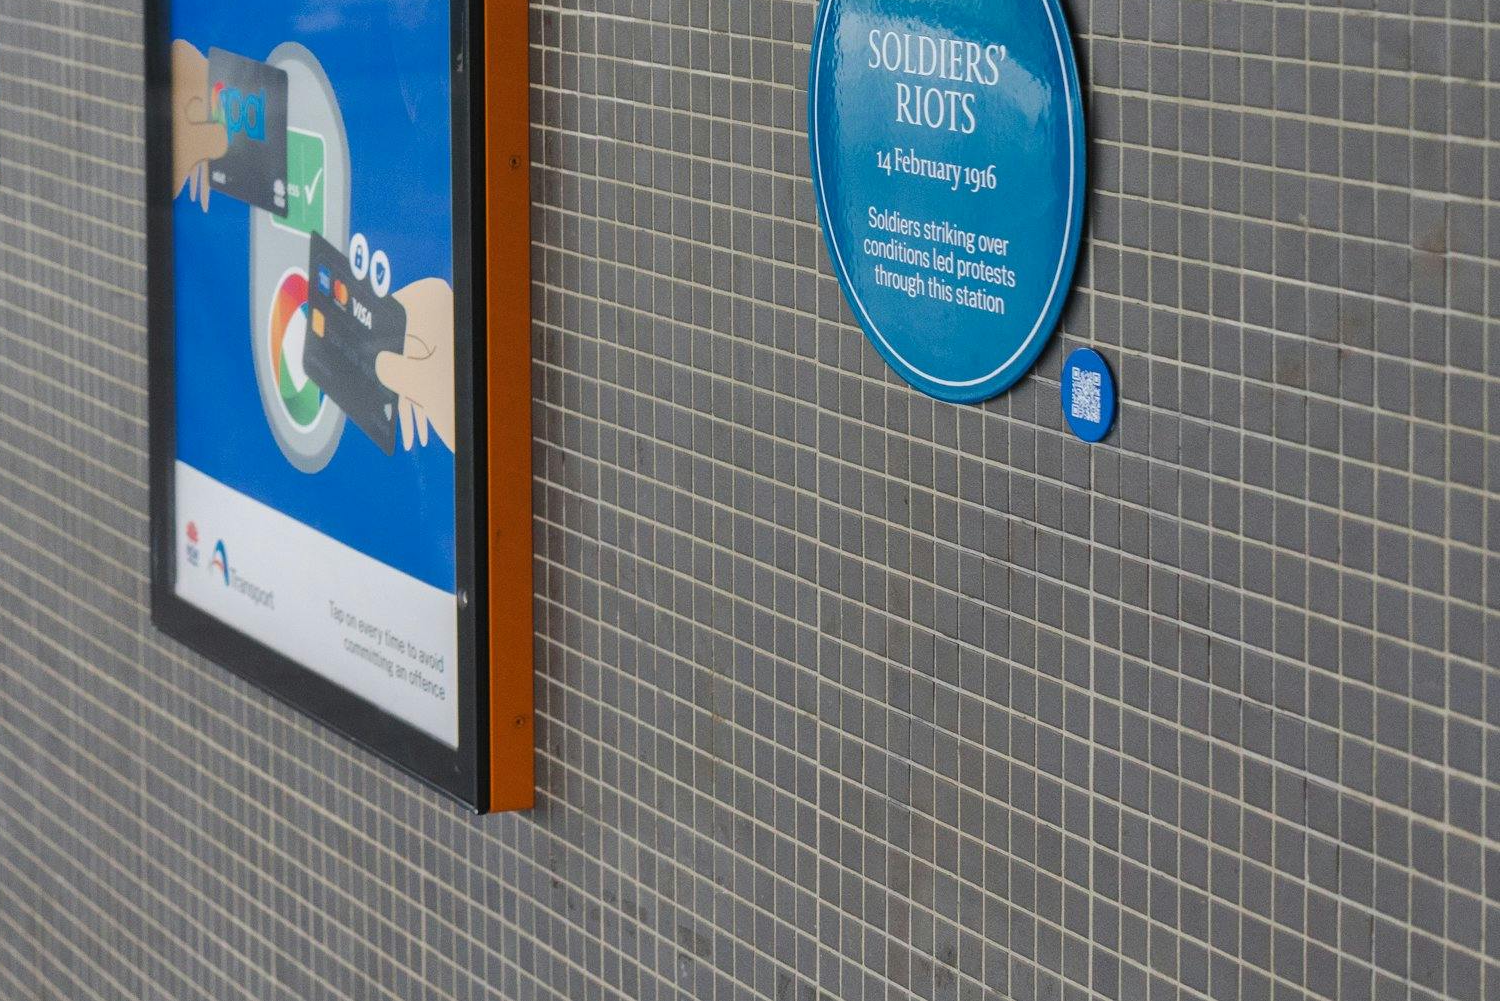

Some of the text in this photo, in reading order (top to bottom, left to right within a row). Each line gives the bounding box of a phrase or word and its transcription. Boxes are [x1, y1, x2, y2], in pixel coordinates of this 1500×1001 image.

[868, 29, 1006, 86] SOLDIERS'
[895, 83, 976, 134] RIOTS
[877, 147, 997, 193] 14 February 1916
[868, 206, 1009, 256] Soldiers striking over
[863, 238, 1016, 288] conditions led protests
[351, 298, 373, 330] VISA
[874, 264, 1005, 315] through this station
[329, 599, 445, 673] Tap on every time to avoid
[343, 638, 446, 700] committing an offence
